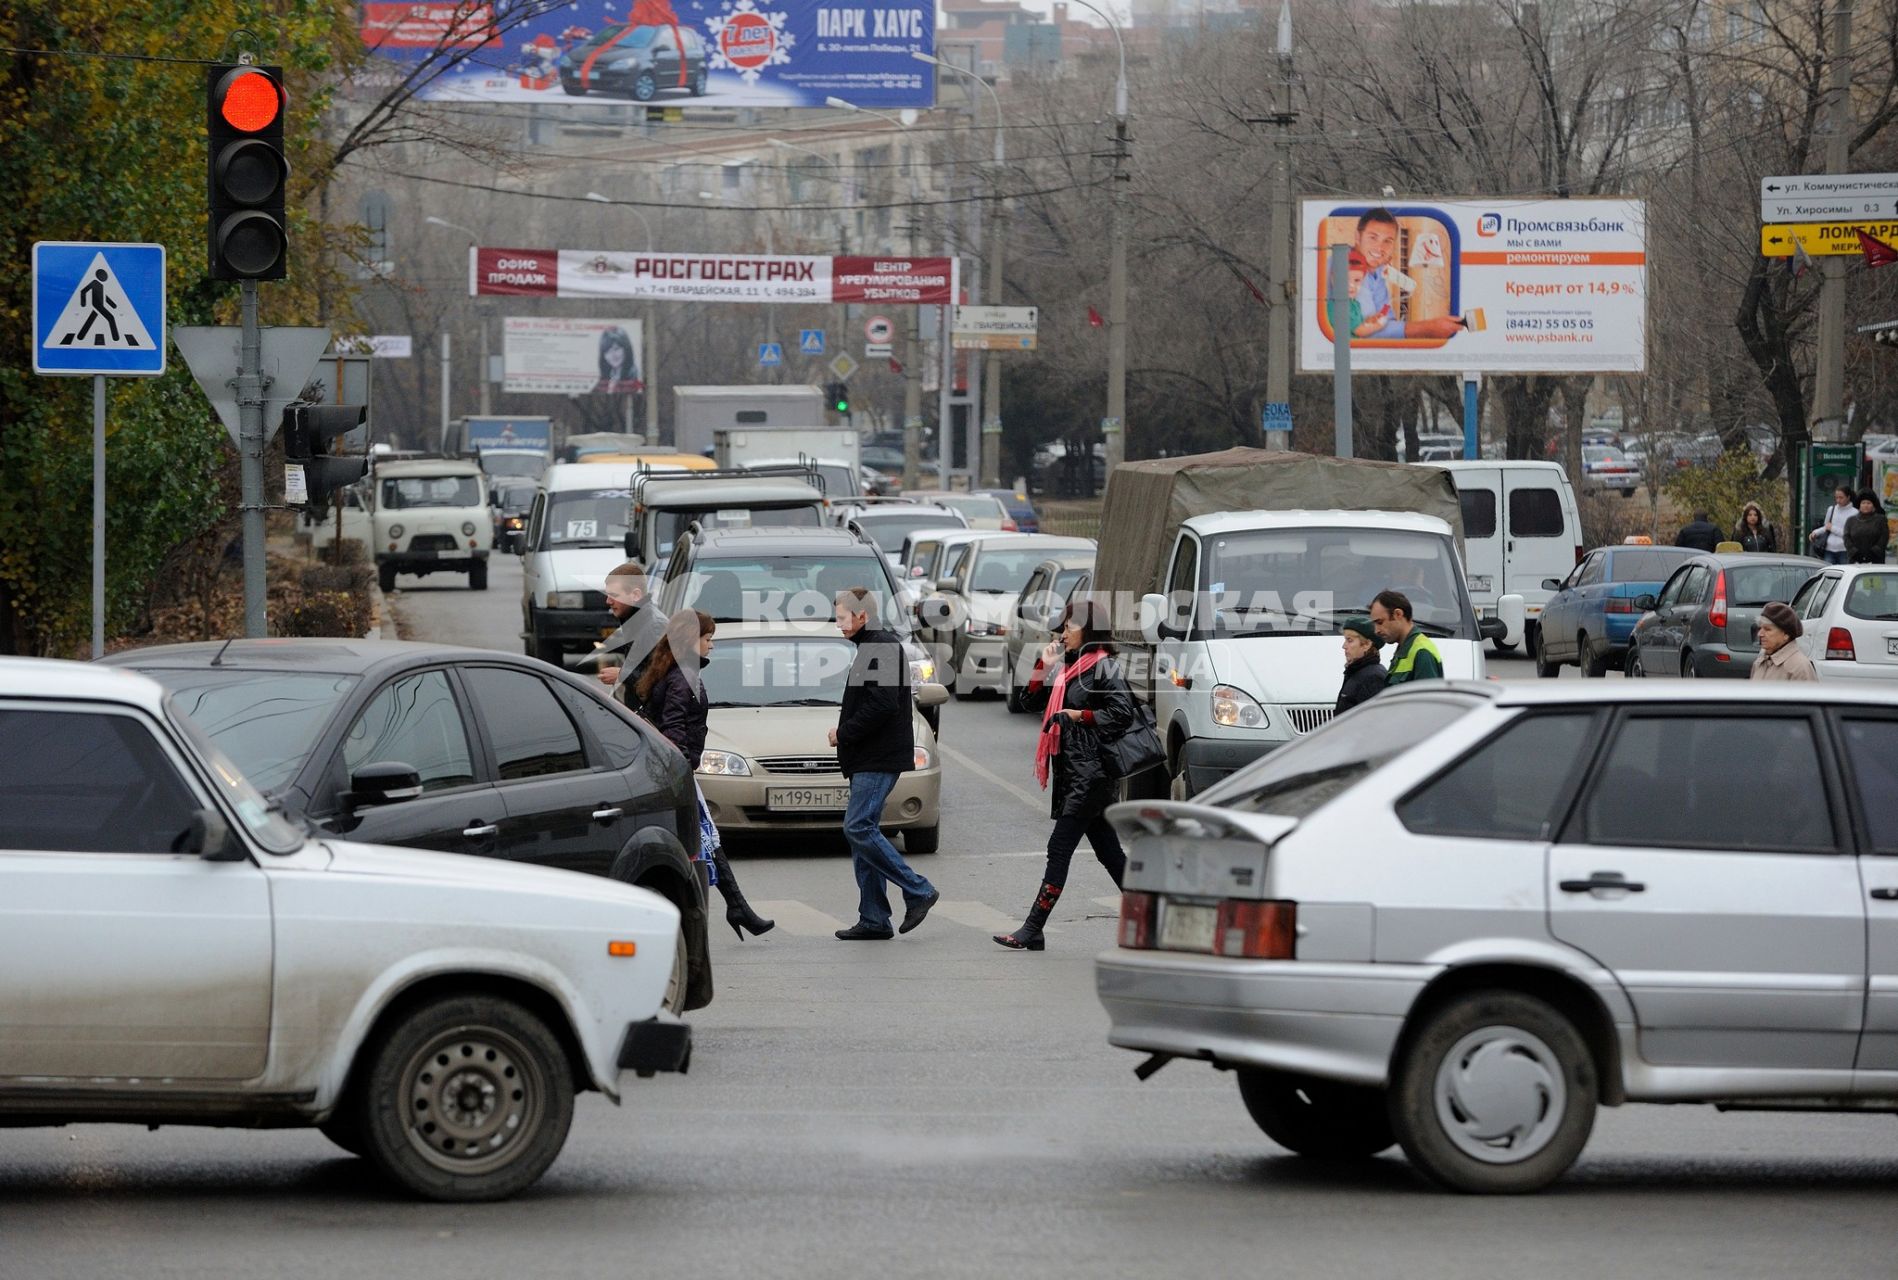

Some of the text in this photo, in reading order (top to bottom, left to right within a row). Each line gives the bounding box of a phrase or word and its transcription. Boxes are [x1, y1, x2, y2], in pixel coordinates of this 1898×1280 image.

[817, 9, 923, 38] ПАРК ХАУС
[726, 26, 769, 41] 7 лет
[1785, 184, 1800, 194] ул.
[1796, 206, 1853, 215] Хиросимы
[1864, 203, 1880, 212] 0.3
[1507, 217, 1624, 234] Промсвязьбанк
[498, 259, 538, 269] ОФИС
[1506, 253, 1590, 265] ремонтируем
[635, 258, 814, 281] РОСГОССТРАХ
[874, 262, 911, 273] ЦЕНТР
[488, 273, 546, 284] ПРОДАЖ
[839, 275, 945, 286] УРЕГУЛИРОВАНИЯ
[864, 288, 921, 299] УБЫТКОВ
[1506, 281, 1562, 297] Кредит
[1566, 284, 1584, 294] от
[1589, 281, 1620, 295] 14,9
[1506, 319, 1593, 329] (8442) 55 05 05
[1506, 333, 1593, 343] www.psbank.ru
[573, 522, 592, 537] 75
